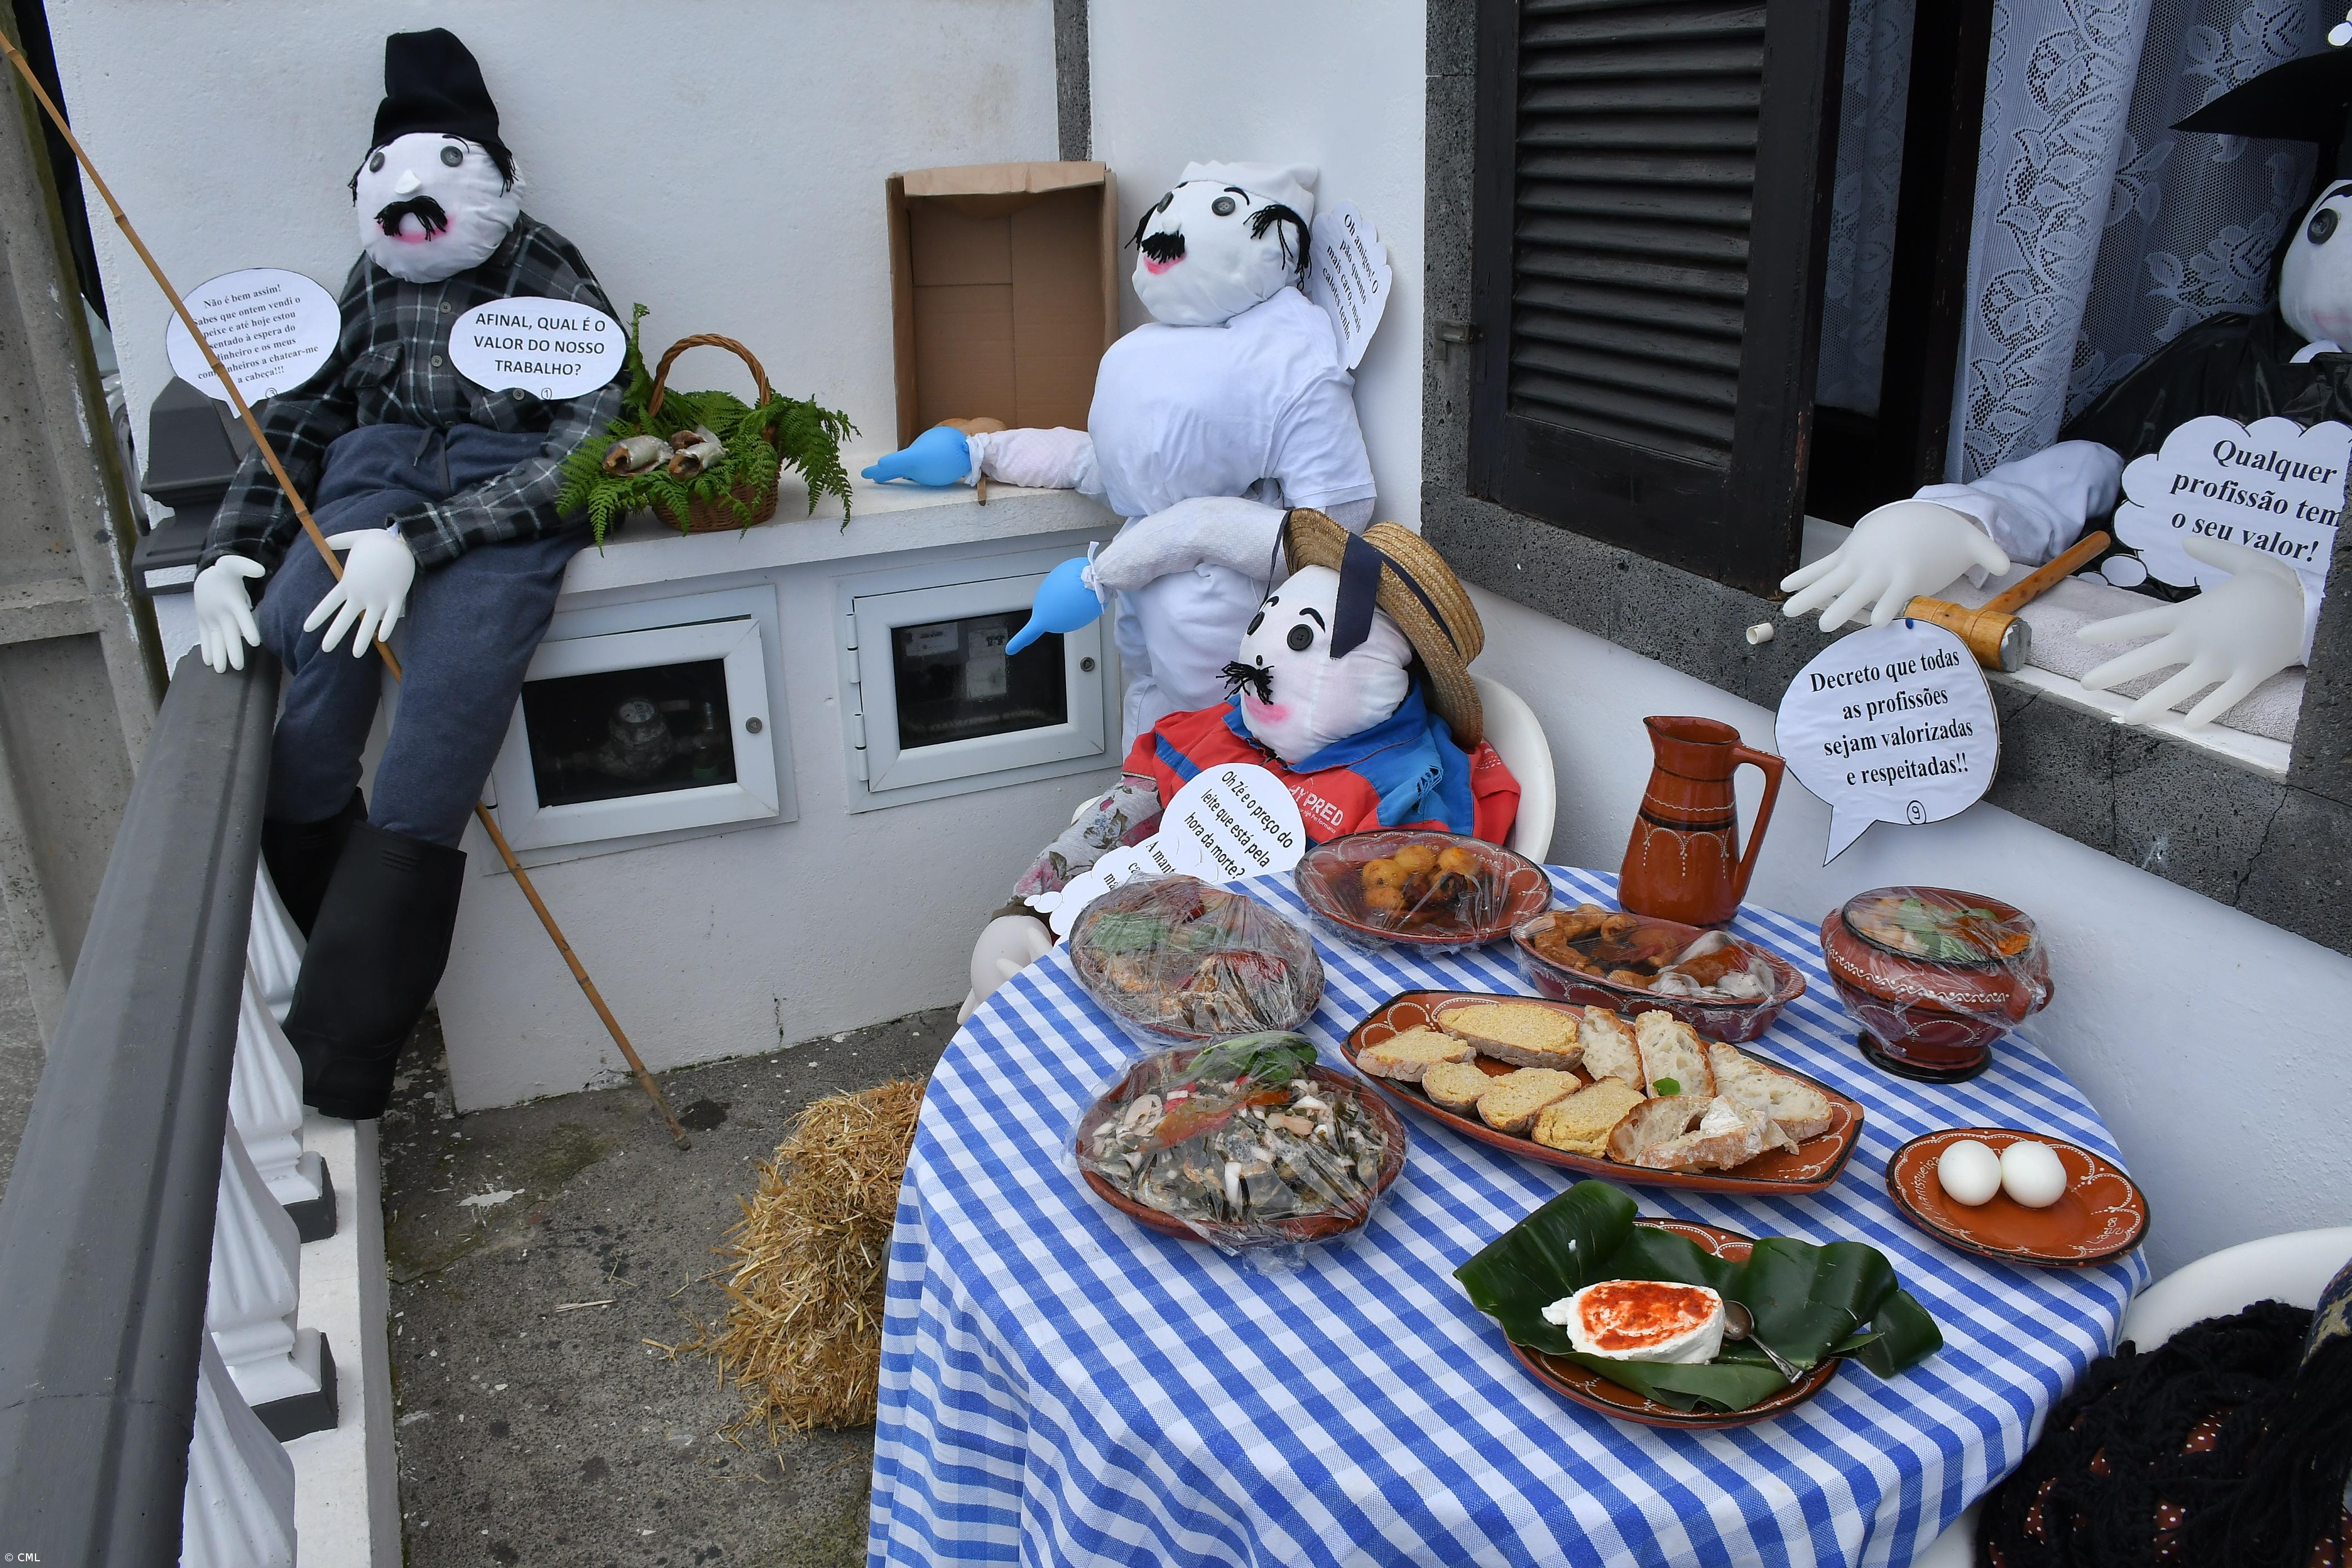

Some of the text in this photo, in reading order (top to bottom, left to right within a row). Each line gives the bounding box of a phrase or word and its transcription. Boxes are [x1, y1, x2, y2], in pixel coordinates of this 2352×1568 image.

[1344, 214, 1378, 293] Oh amigos! O
[1339, 239, 1366, 304] pão quanto
[203, 299, 222, 309] Não
[231, 293, 251, 302] bem
[253, 284, 282, 297] assim!
[1323, 268, 1350, 344] calotes tenho.
[1327, 245, 1361, 333] mais caro, mais
[203, 327, 226, 340] peixe
[236, 320, 250, 331] até
[252, 316, 270, 328] hoje
[273, 311, 296, 322] estou
[220, 311, 236, 322] que
[239, 305, 266, 316] ontem
[269, 297, 293, 309] vendi
[475, 313, 605, 332] AFINAL, QUAL É O
[209, 335, 243, 349] sentado
[253, 329, 282, 340] espera
[284, 324, 296, 333] do
[273, 338, 296, 349] meus
[474, 336, 604, 354] VALOR DO NOSSO
[198, 358, 259, 379] comnheiros
[269, 346, 318, 363] chatear-me
[245, 366, 284, 382] cabeça!!!
[495, 359, 581, 376] TRABALHO?
[2213, 440, 2337, 484] Qualquer
[2168, 474, 2342, 527] profissão tem
[2171, 513, 2319, 562] o seu valor!
[1809, 648, 1959, 692] Decreto que todas
[1842, 688, 1948, 721] as profissões
[1824, 718, 1973, 759] sejam valorizadas
[1847, 752, 1968, 786] e respeitadas!!
[1222, 770, 1293, 848] Oh Zé e o preço do
[1184, 812, 1245, 879] hora da morte?
[1200, 789, 1270, 868] leite que está pela
[1128, 862, 1141, 874] ca
[1146, 840, 1177, 874] A mant
[1103, 873, 1119, 890] ma
